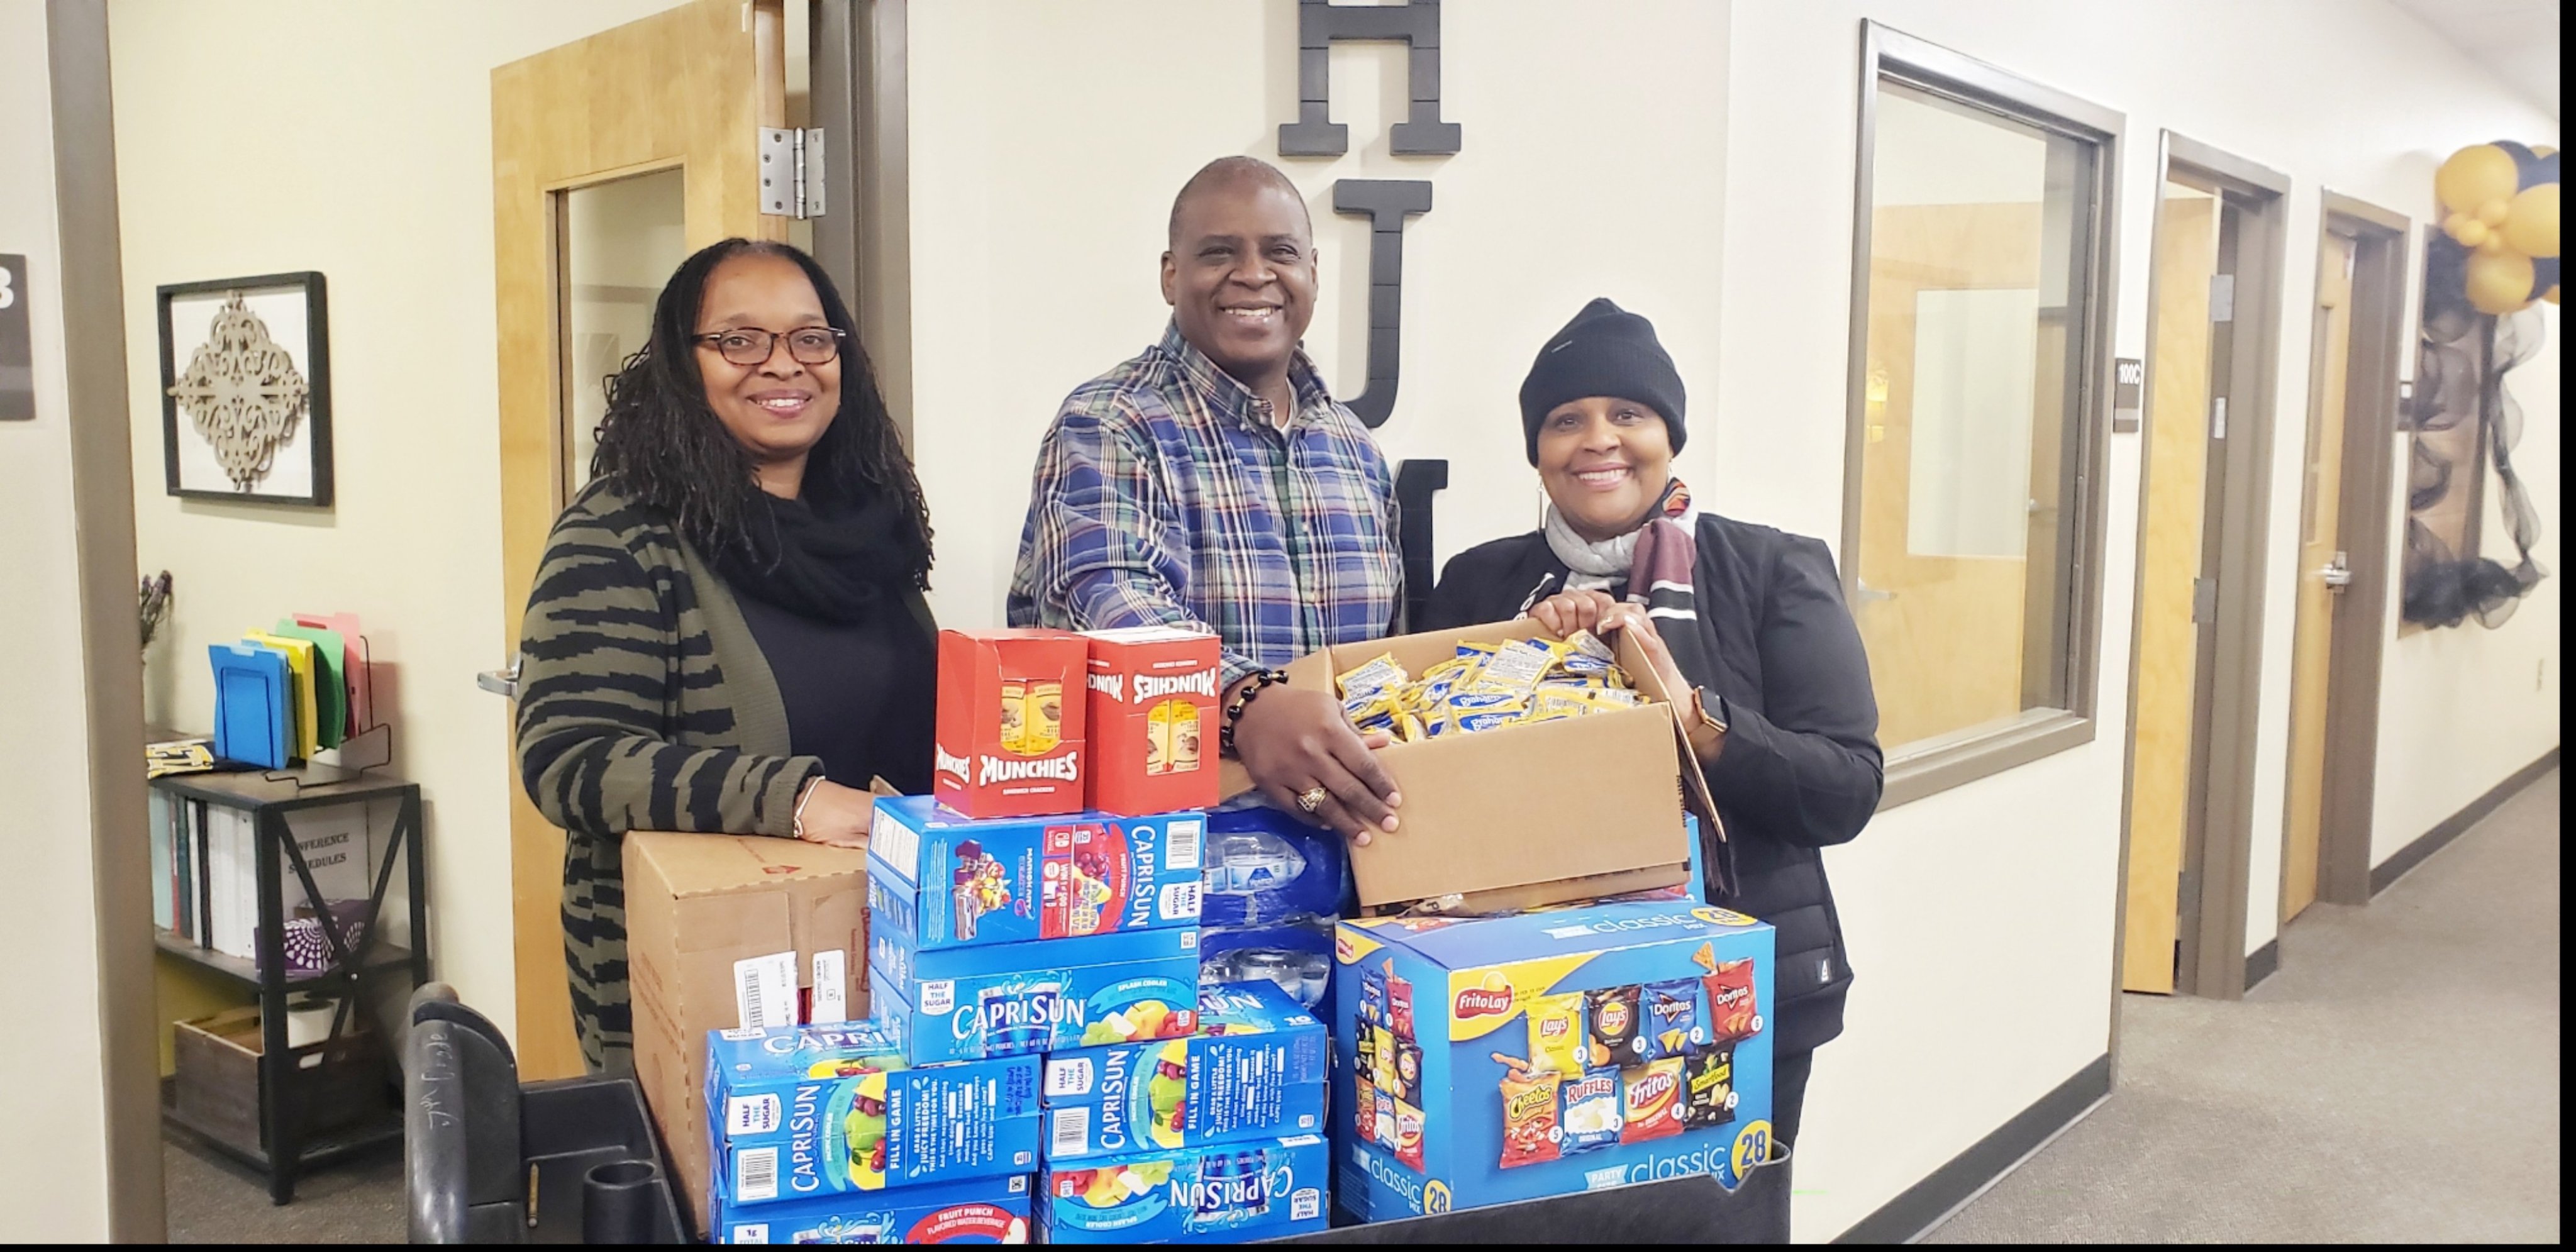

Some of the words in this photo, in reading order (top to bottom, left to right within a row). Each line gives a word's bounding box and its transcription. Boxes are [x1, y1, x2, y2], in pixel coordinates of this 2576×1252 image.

[1133, 668, 1216, 704] MUNCHIES
[936, 743, 970, 784] MUNCHIES
[979, 751, 1078, 787] MUNCHIES
[1187, 885, 1196, 914] HALF
[928, 982, 948, 990] HALF
[1716, 985, 1748, 1005] Doritos
[924, 999, 951, 1007] SUGAR
[1654, 1000, 1691, 1016] Doritos
[1602, 1010, 1627, 1027] Lay's
[1578, 1050, 1583, 1060] 3
[1191, 1055, 1201, 1090] GAME
[1694, 1068, 1727, 1090] Smartfood
[1191, 1092, 1199, 1104] IN
[1510, 1085, 1552, 1119] Cheetos
[1568, 1078, 1612, 1103] RUFFLES
[1630, 1072, 1674, 1109] Fritos
[742, 1104, 750, 1127] HALF
[891, 1089, 902, 1126] GAME
[1188, 1106, 1197, 1129] FILL
[891, 1129, 901, 1143] IN
[1553, 1129, 1559, 1139] 5
[890, 1145, 900, 1170] FILL
[1741, 1129, 1767, 1166] 28
[1631, 1143, 1726, 1183] classic
[1371, 1158, 1421, 1205] classic
[1591, 1169, 1623, 1183] PARTY
[938, 1209, 963, 1222] FRUIT
[964, 1207, 994, 1217] PUNCH
